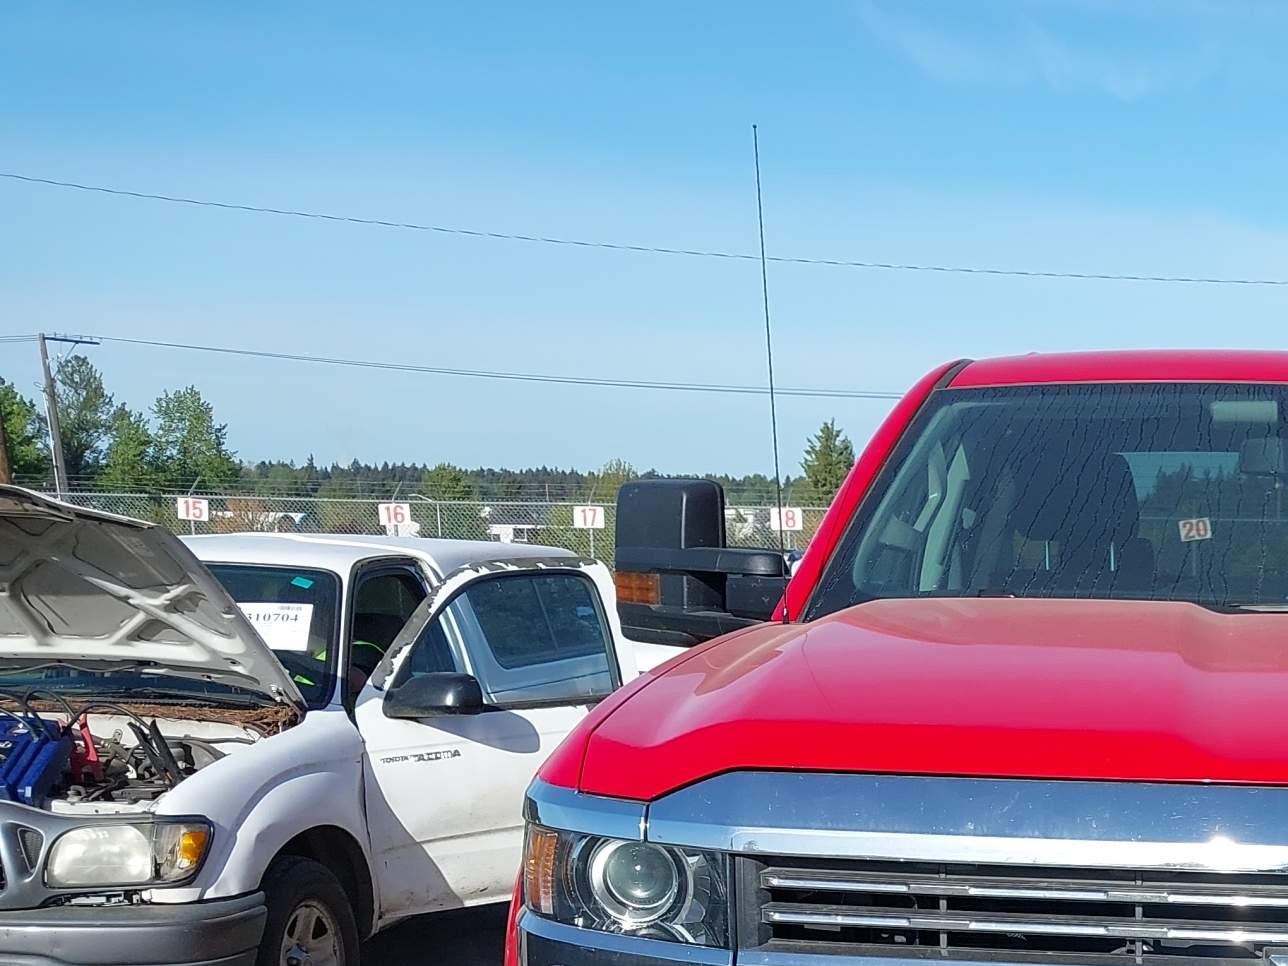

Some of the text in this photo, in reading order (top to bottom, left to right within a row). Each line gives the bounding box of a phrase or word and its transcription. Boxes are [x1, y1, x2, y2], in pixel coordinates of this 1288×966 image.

[183, 501, 204, 519] 15
[385, 503, 406, 523] 16
[580, 508, 598, 526] 17
[1183, 520, 1208, 539] 20
[410, 749, 462, 762] TACOMA
